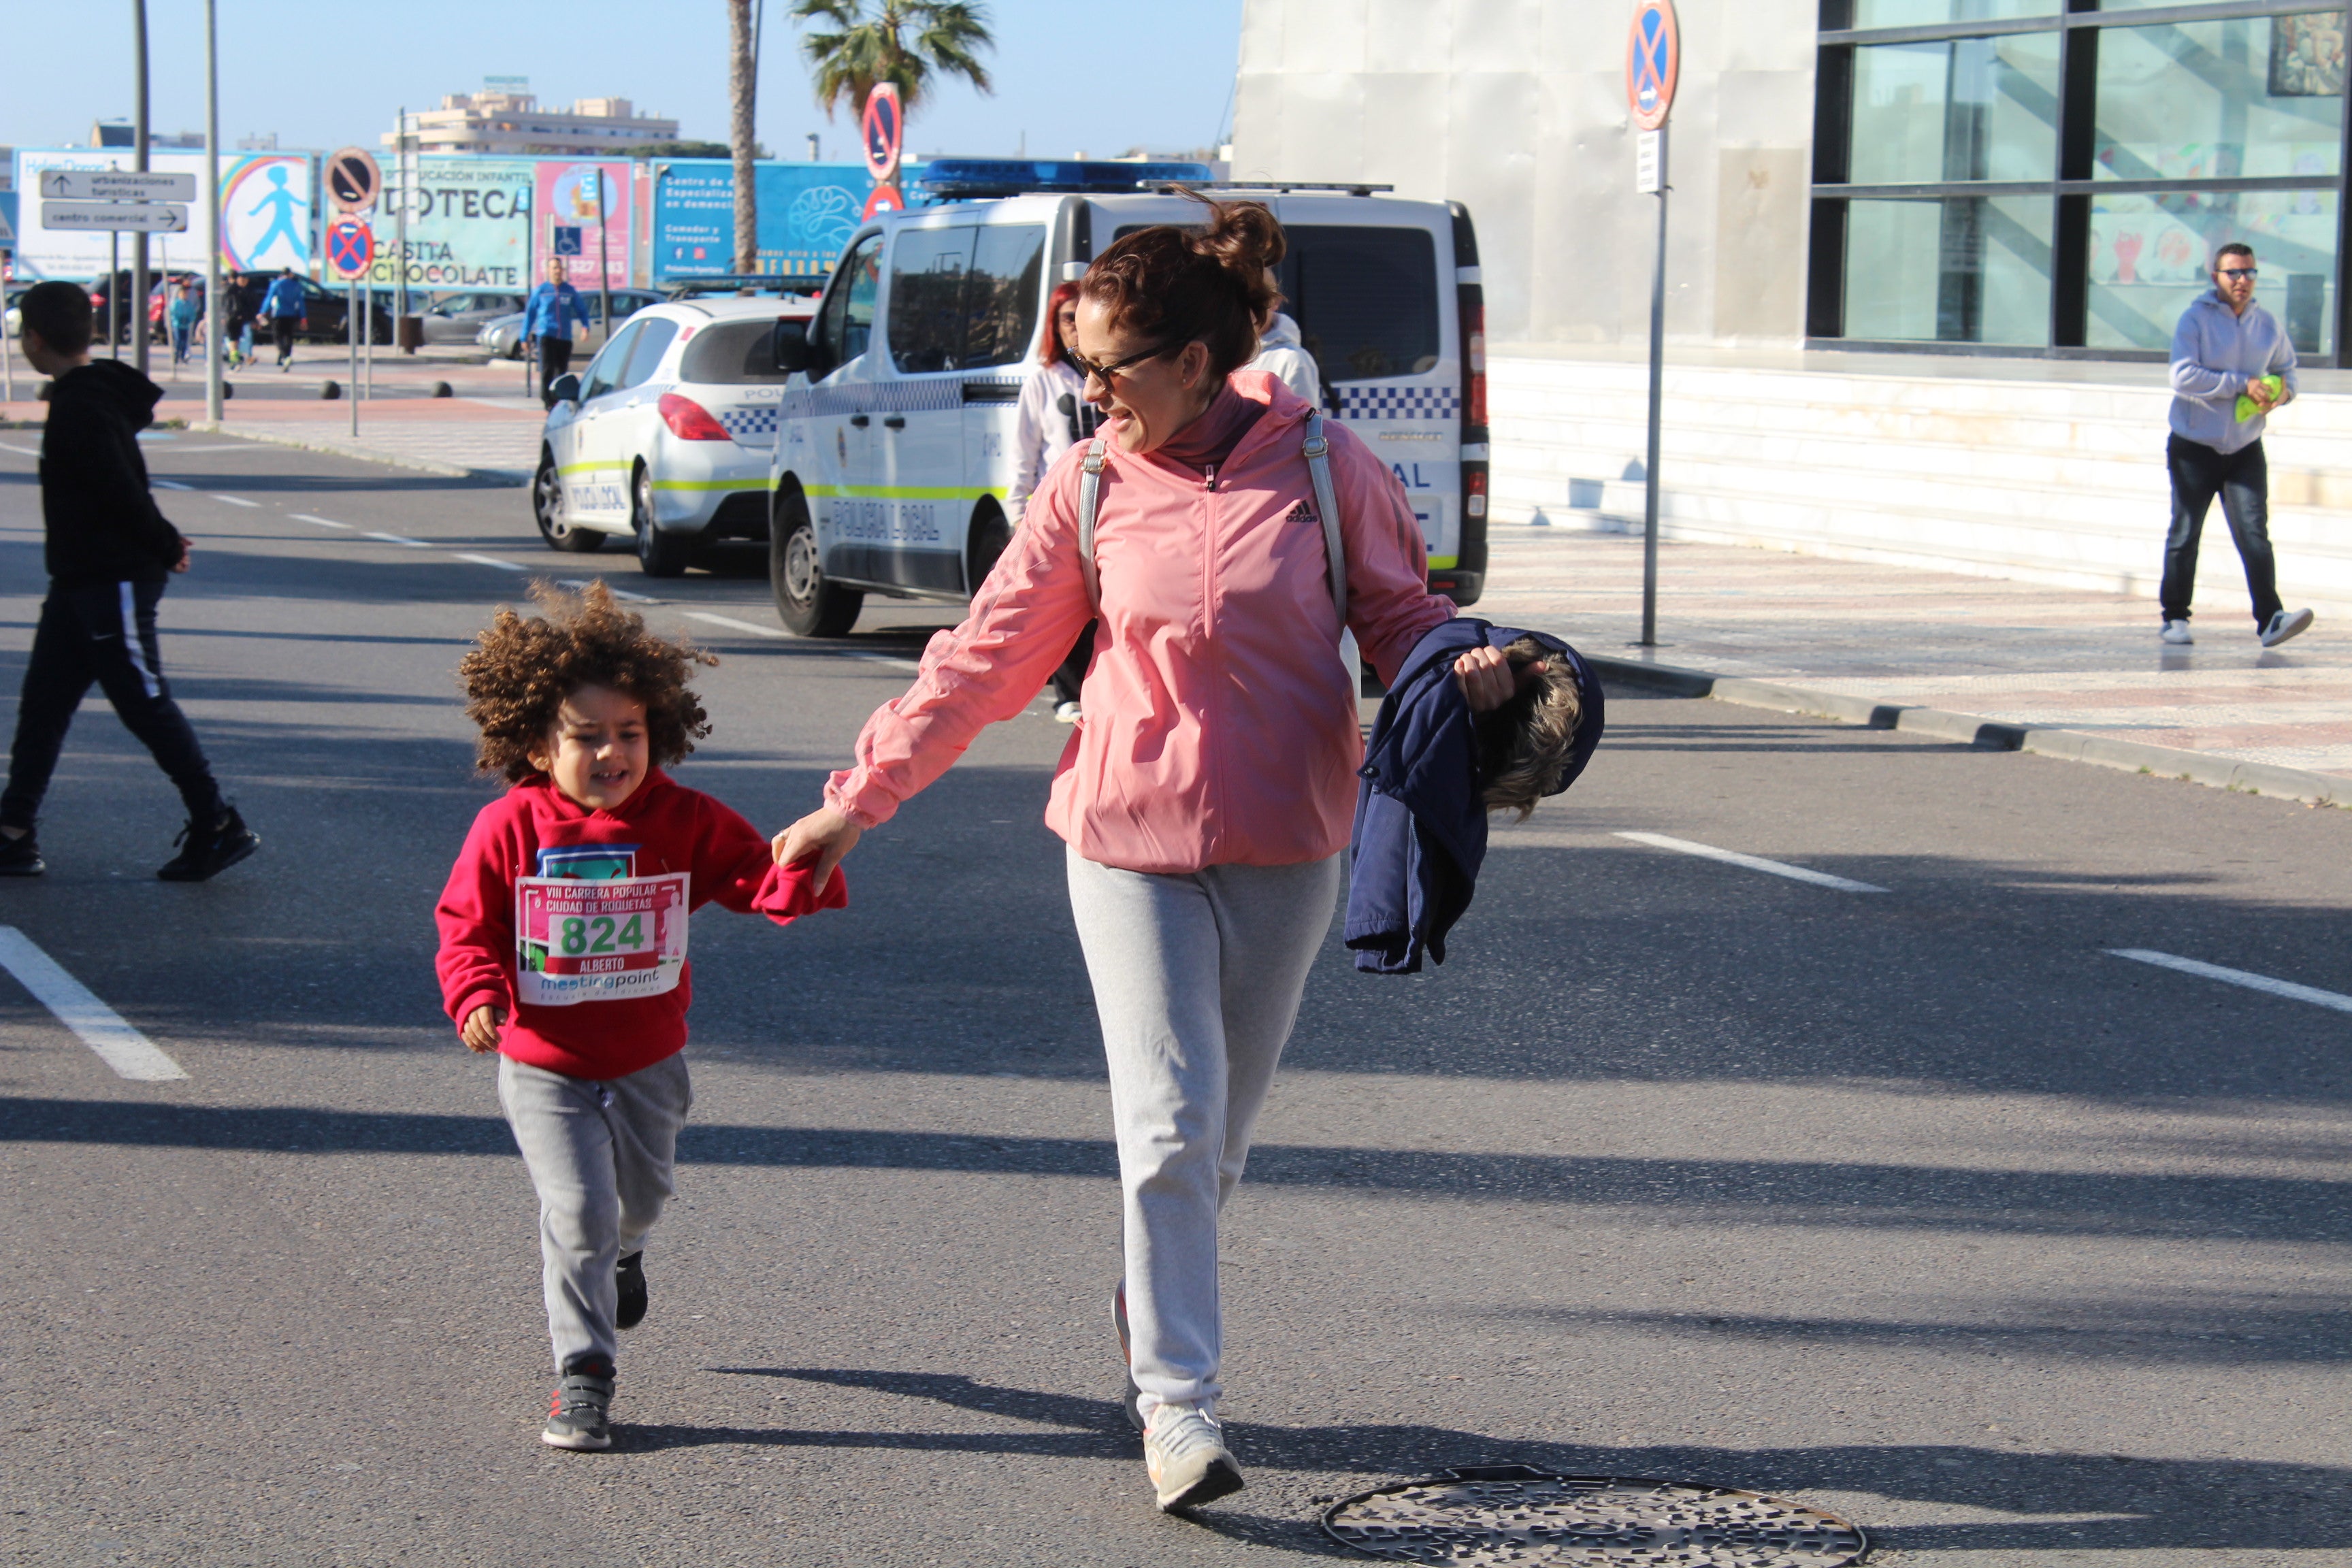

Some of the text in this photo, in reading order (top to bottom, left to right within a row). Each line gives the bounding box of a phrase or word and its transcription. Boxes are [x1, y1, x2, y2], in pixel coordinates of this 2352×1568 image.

[91, 176, 174, 186] urbanizaciones
[666, 177, 706, 186] Centro
[666, 187, 734, 198] Especializa
[683, 200, 733, 209] demenci
[52, 212, 148, 223] centro comercial
[666, 234, 721, 243] Transporte
[1286, 514, 1318, 523] adidas
[546, 884, 657, 900] VIII CARRERA POPULAR
[546, 898, 653, 913] CIUDAD DE ROQUETAS
[561, 914, 644, 955] 824
[579, 957, 625, 974] ALBERTO
